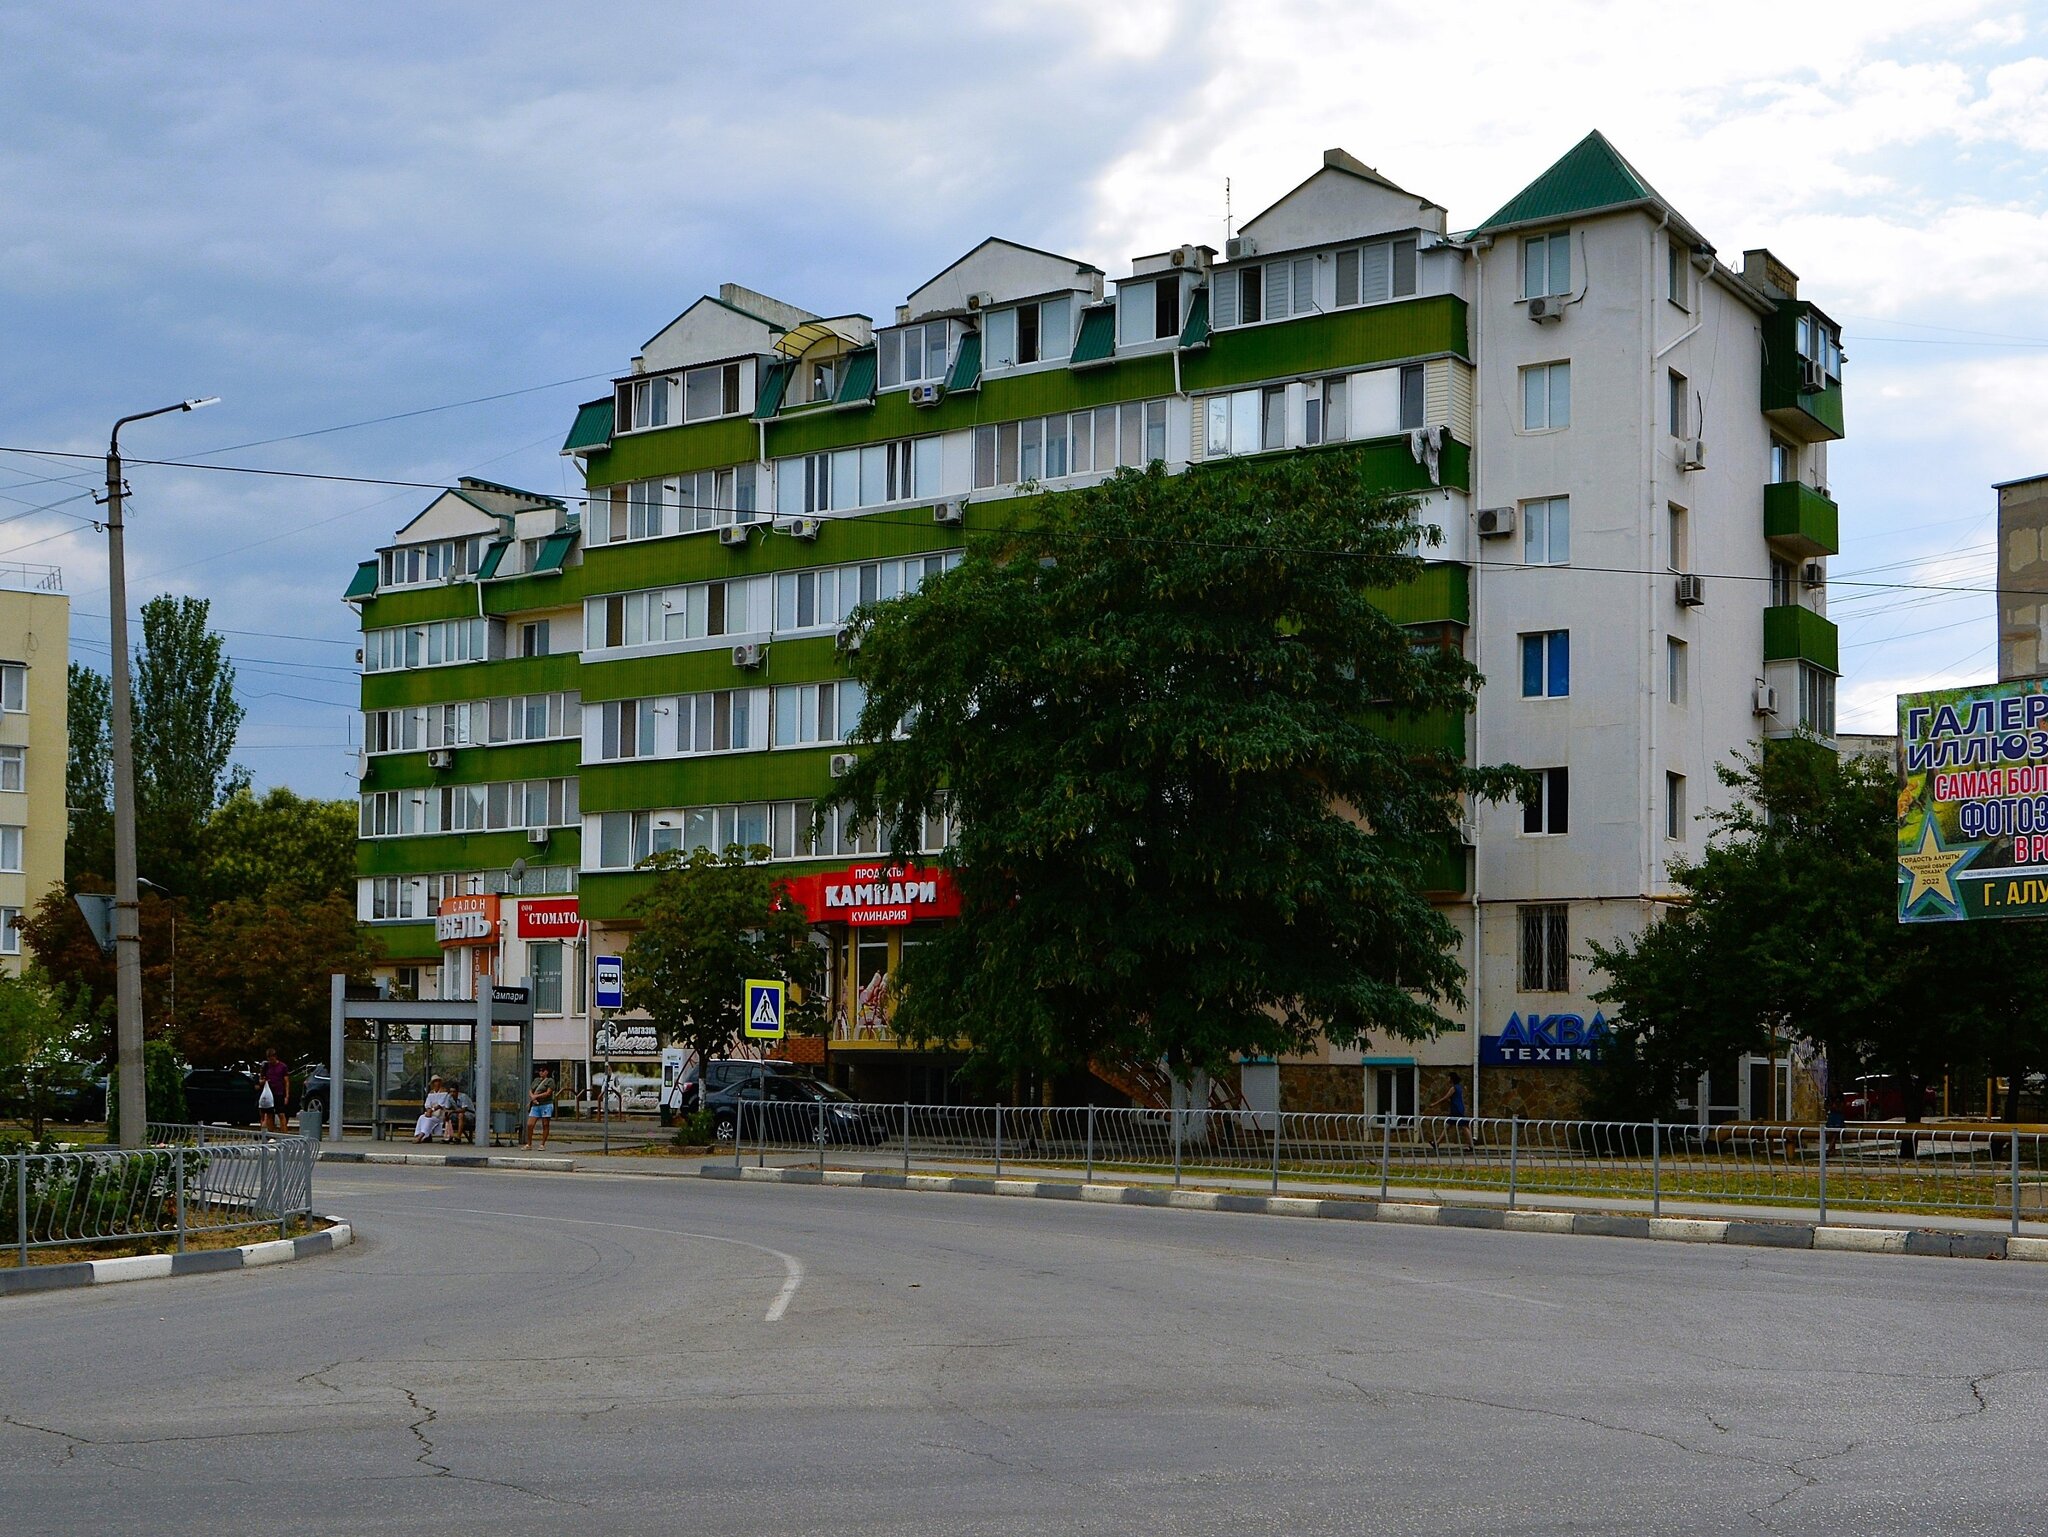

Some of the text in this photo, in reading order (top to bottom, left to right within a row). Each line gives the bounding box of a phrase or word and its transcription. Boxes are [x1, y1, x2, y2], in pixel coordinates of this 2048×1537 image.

[1908, 695, 2048, 741] ГАЛЕР
[1908, 732, 2048, 770] ИЛЛЮЗ
[1935, 765, 2048, 801] САМАЯ БОЛ
[1961, 796, 2048, 837] ФОТОЗ
[1934, 853, 1960, 861] АЛУШТЫ
[2015, 836, 2029, 863] В
[855, 866, 904, 879] ПРОДКТЫ
[453, 899, 485, 912] САЛОН
[825, 881, 936, 907] КАМПАРИ
[1984, 880, 2048, 906] Г. АЛУ
[437, 911, 491, 940] ЕБЕЛЬ
[851, 910, 907, 922] КУЛИНАРИЯ
[491, 989, 524, 1003] Кампари
[1497, 1010, 1612, 1046] АКВА
[1501, 1048, 1605, 1060] ТЕХНИ
